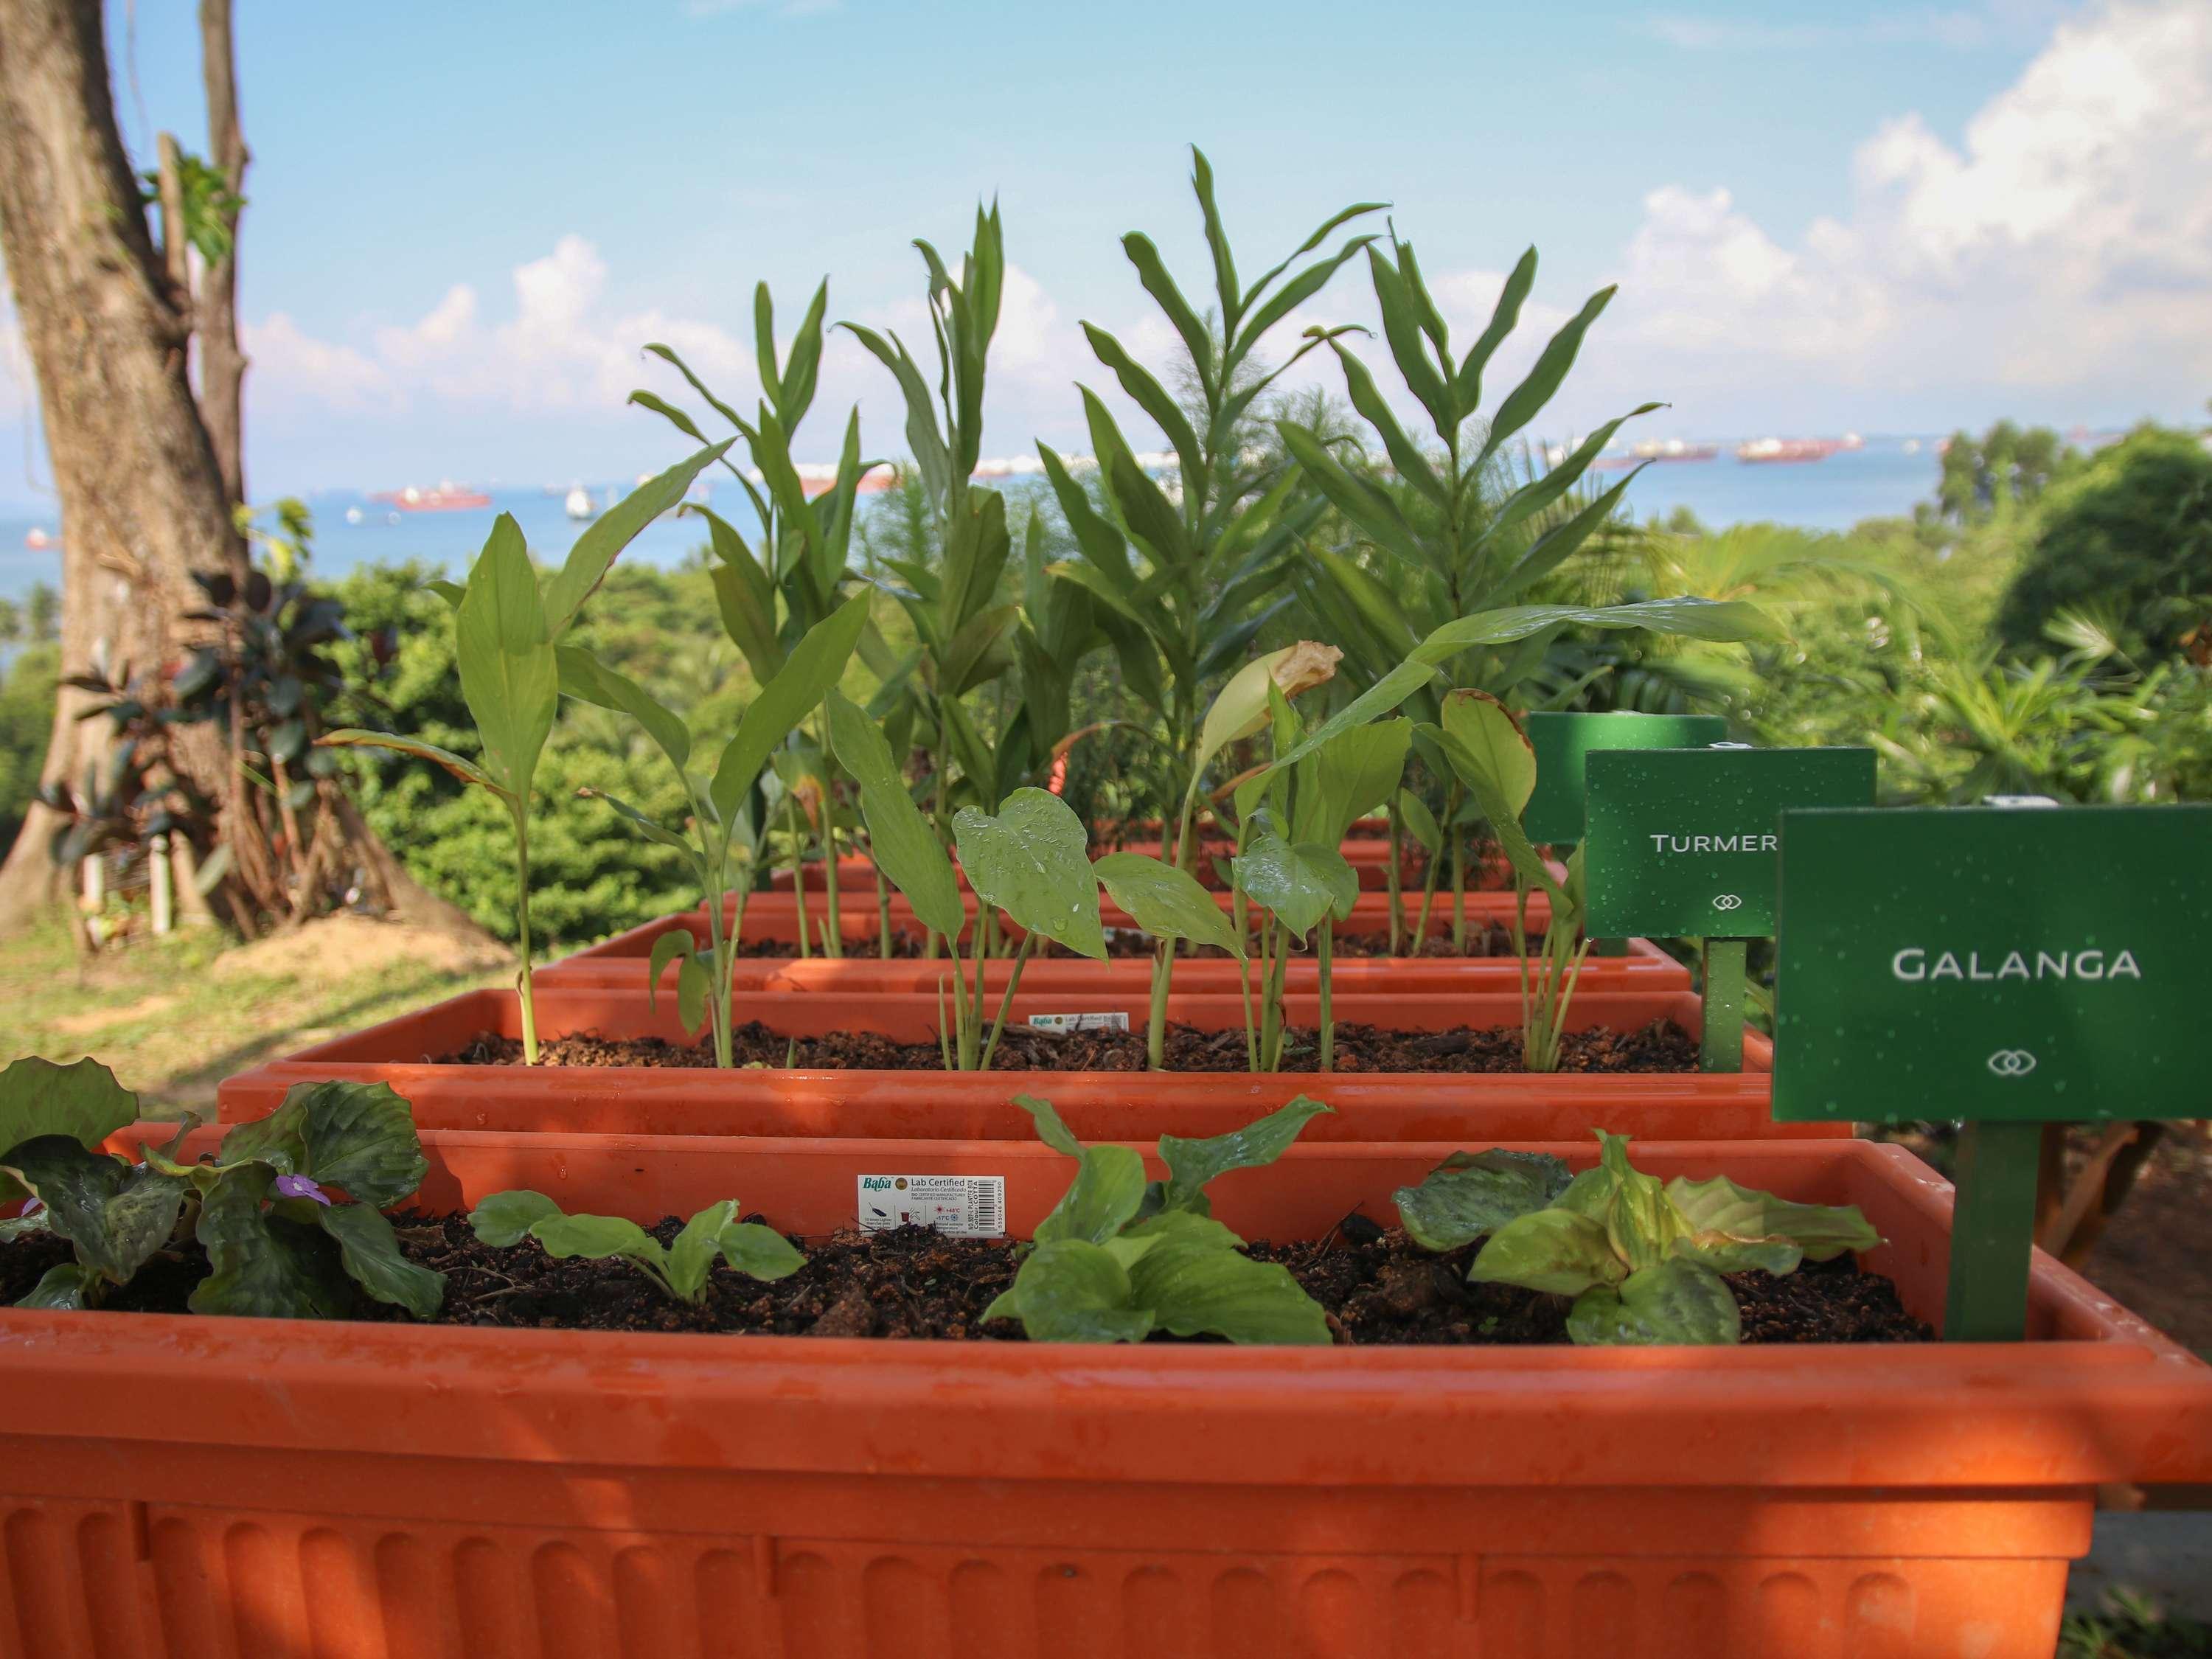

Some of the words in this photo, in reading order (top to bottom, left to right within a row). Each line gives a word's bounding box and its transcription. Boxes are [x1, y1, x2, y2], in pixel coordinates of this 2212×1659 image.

[1649, 834, 1778, 853] TURMER
[1892, 948, 2141, 981] GALANGA
[863, 1177, 891, 1192] Baba
